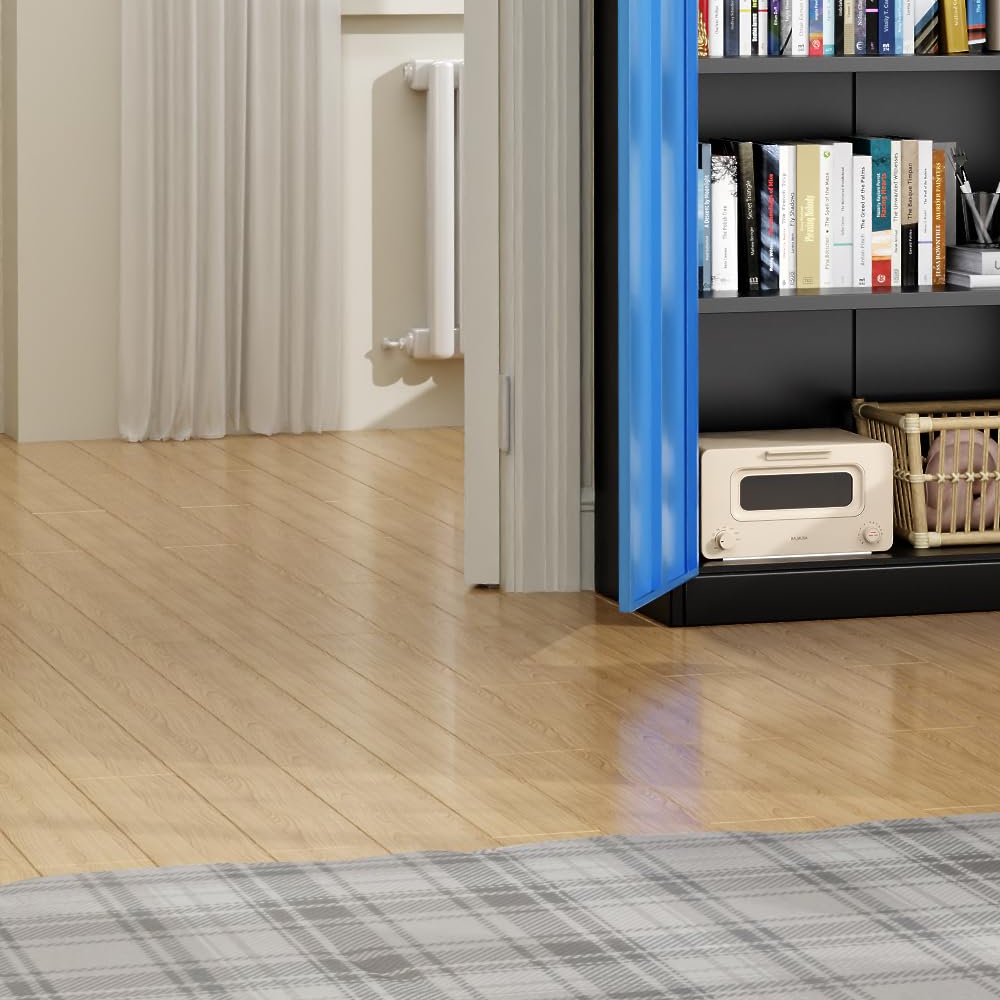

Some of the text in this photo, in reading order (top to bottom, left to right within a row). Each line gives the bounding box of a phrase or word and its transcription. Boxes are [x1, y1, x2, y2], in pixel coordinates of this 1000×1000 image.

[703, 174, 711, 199] Moonlight
[745, 180, 753, 202] Triangle
[881, 195, 889, 218] Racing
